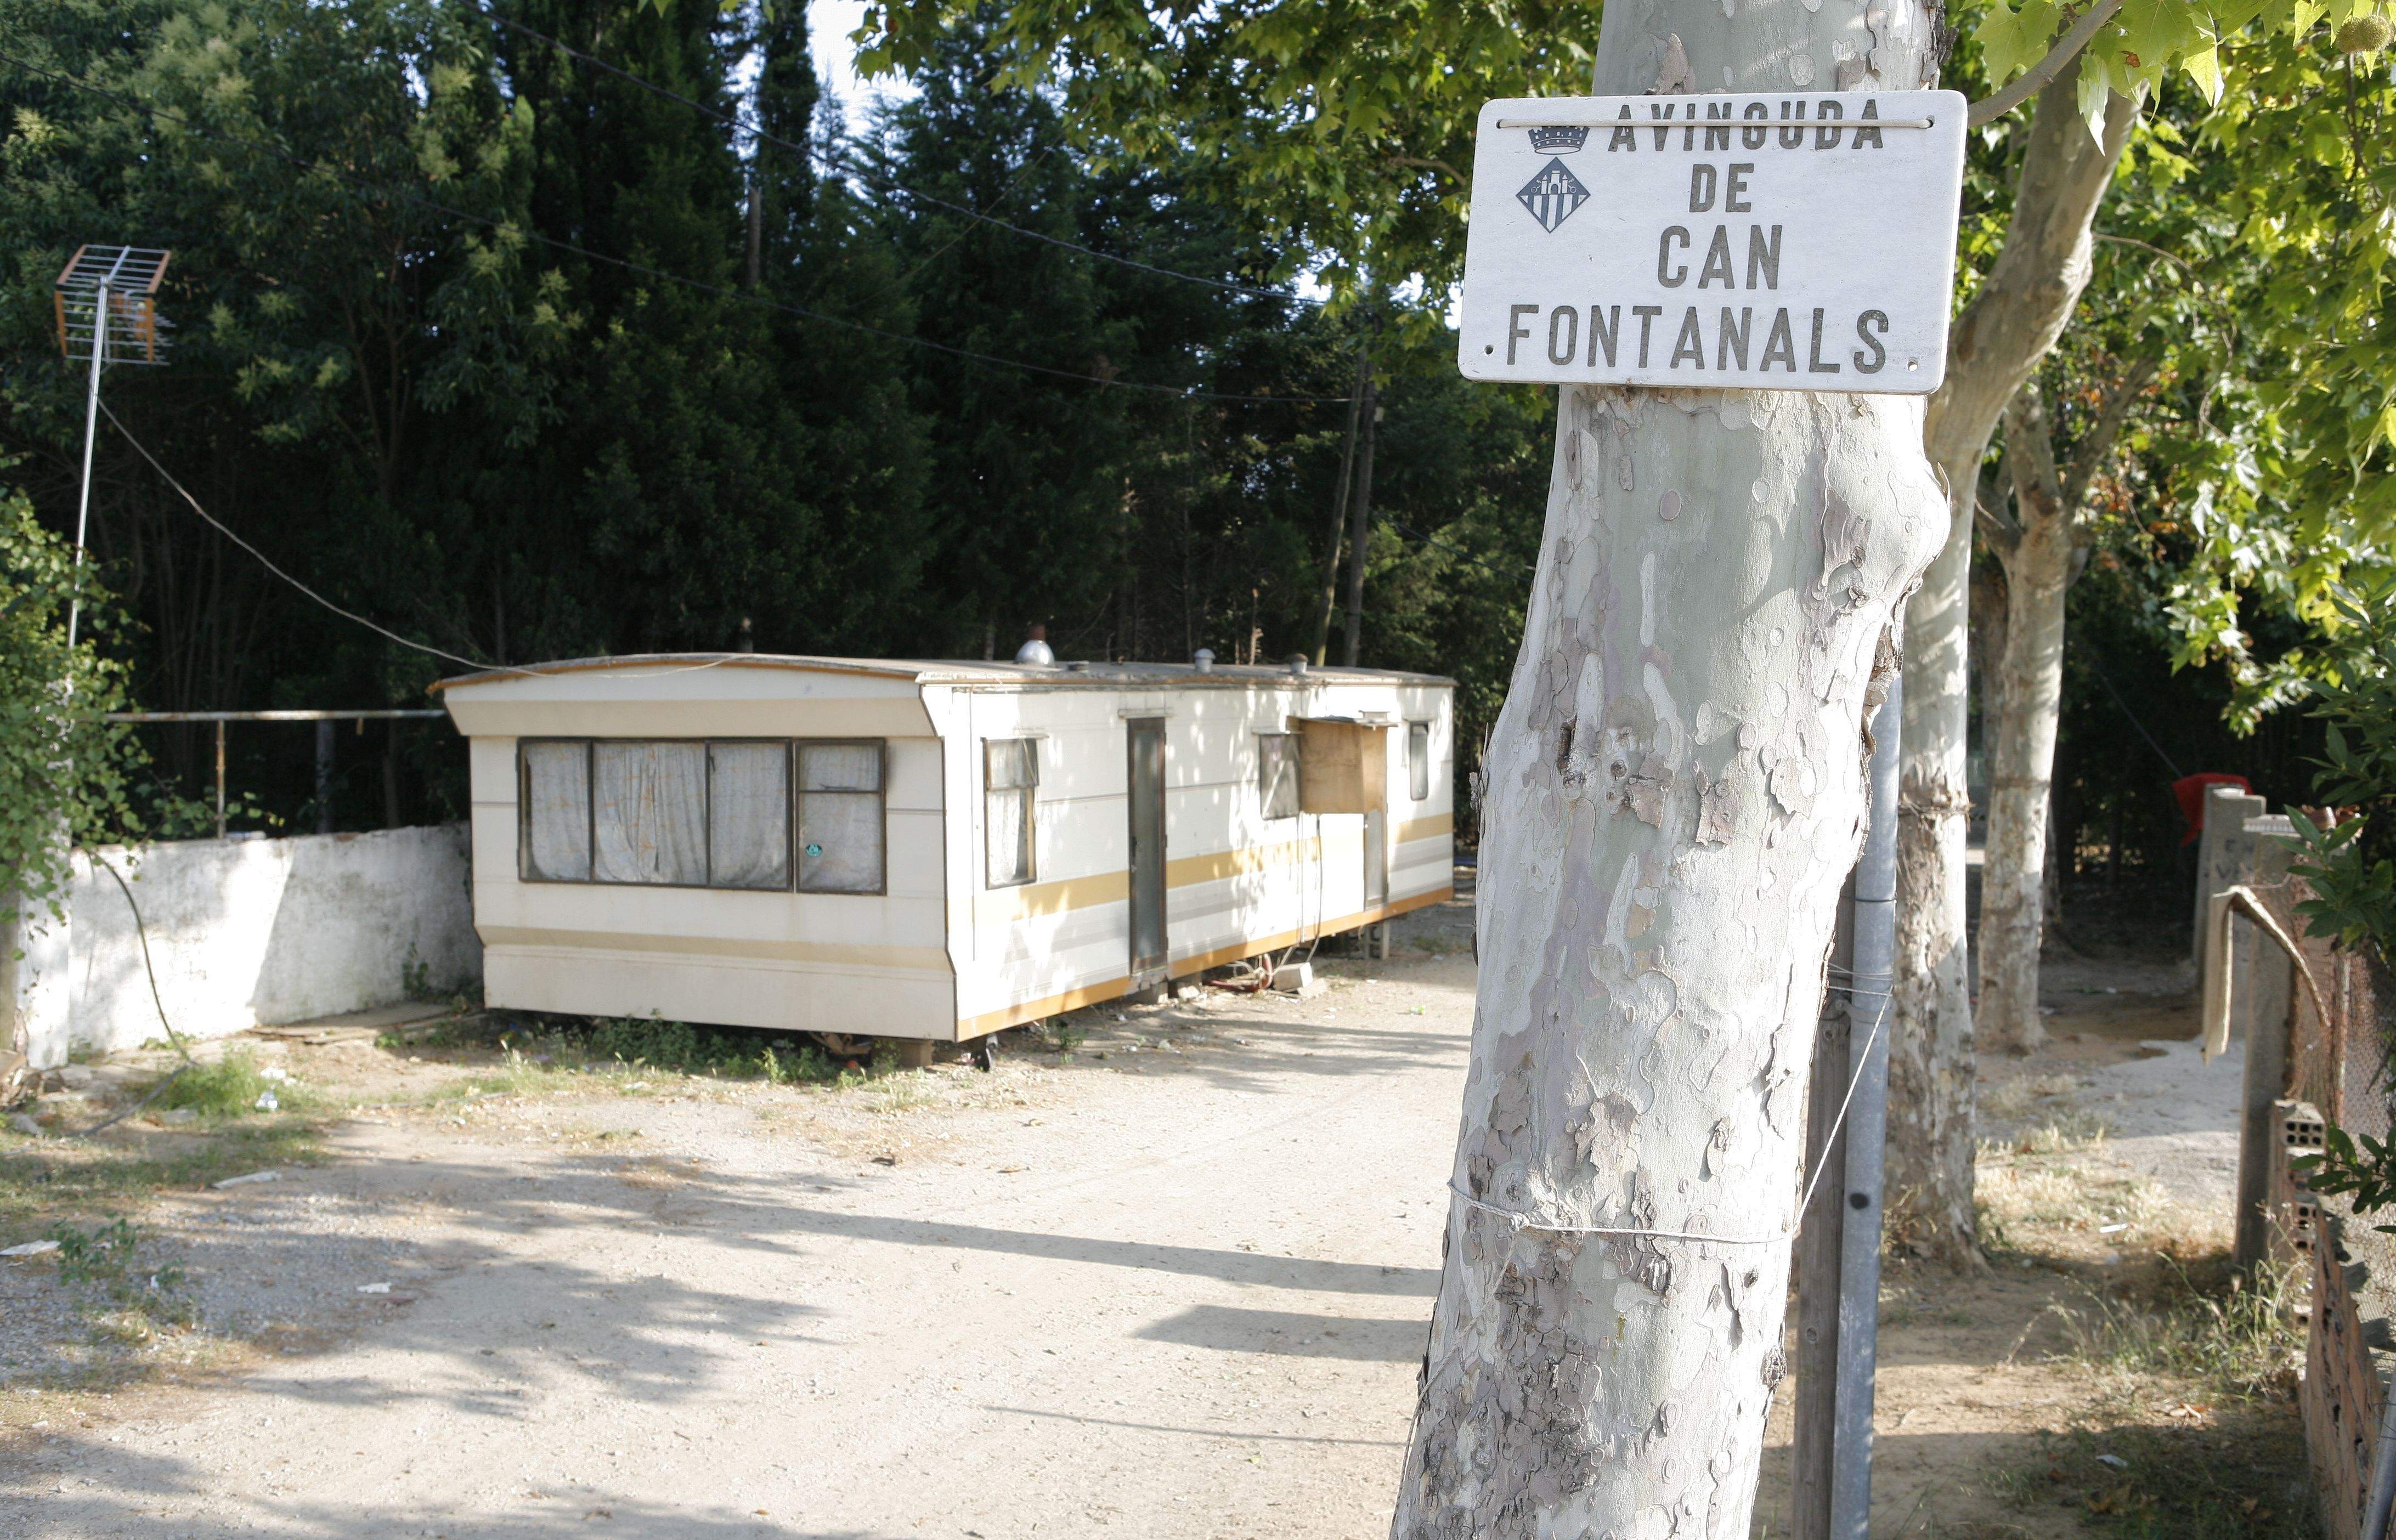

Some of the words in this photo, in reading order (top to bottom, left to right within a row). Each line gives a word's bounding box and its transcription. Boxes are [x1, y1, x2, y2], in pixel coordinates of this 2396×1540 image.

[1608, 99, 1883, 152] AVINGUDA
[1689, 163, 1754, 213] DE
[1657, 225, 1783, 290] CAN
[1507, 304, 1889, 374] FONTANALS
